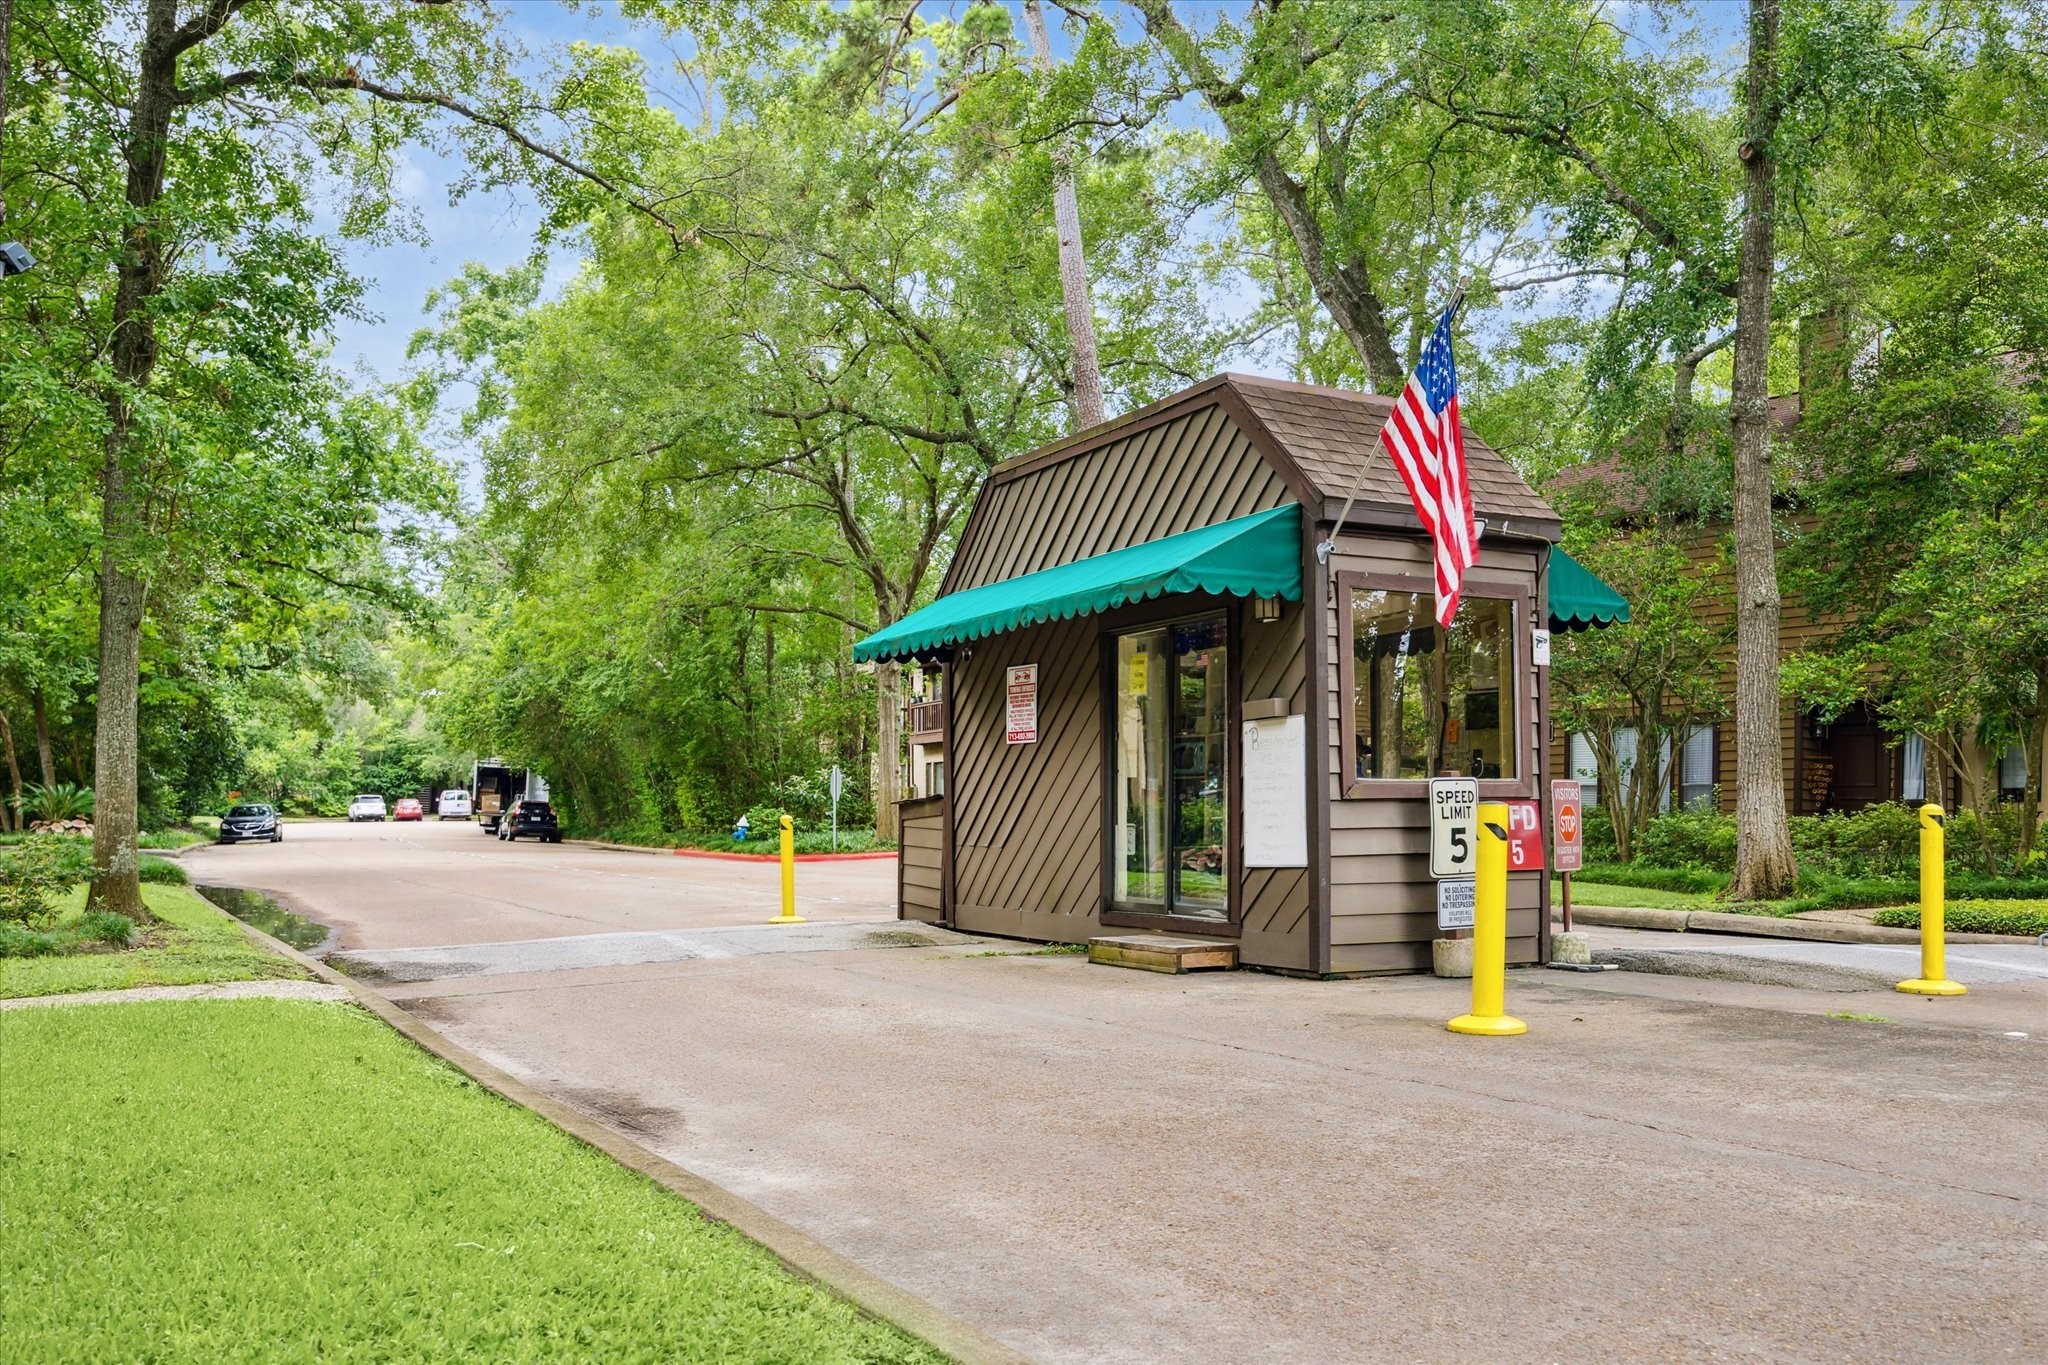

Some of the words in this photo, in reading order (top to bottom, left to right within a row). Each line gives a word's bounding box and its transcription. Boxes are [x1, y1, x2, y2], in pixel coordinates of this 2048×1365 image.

[1436, 790, 1474, 804] SPEED
[1554, 787, 1579, 800] VISITORS
[1441, 806, 1471, 820] LIMIT
[1560, 815, 1576, 833] STOP
[1450, 827, 1468, 864] 5
